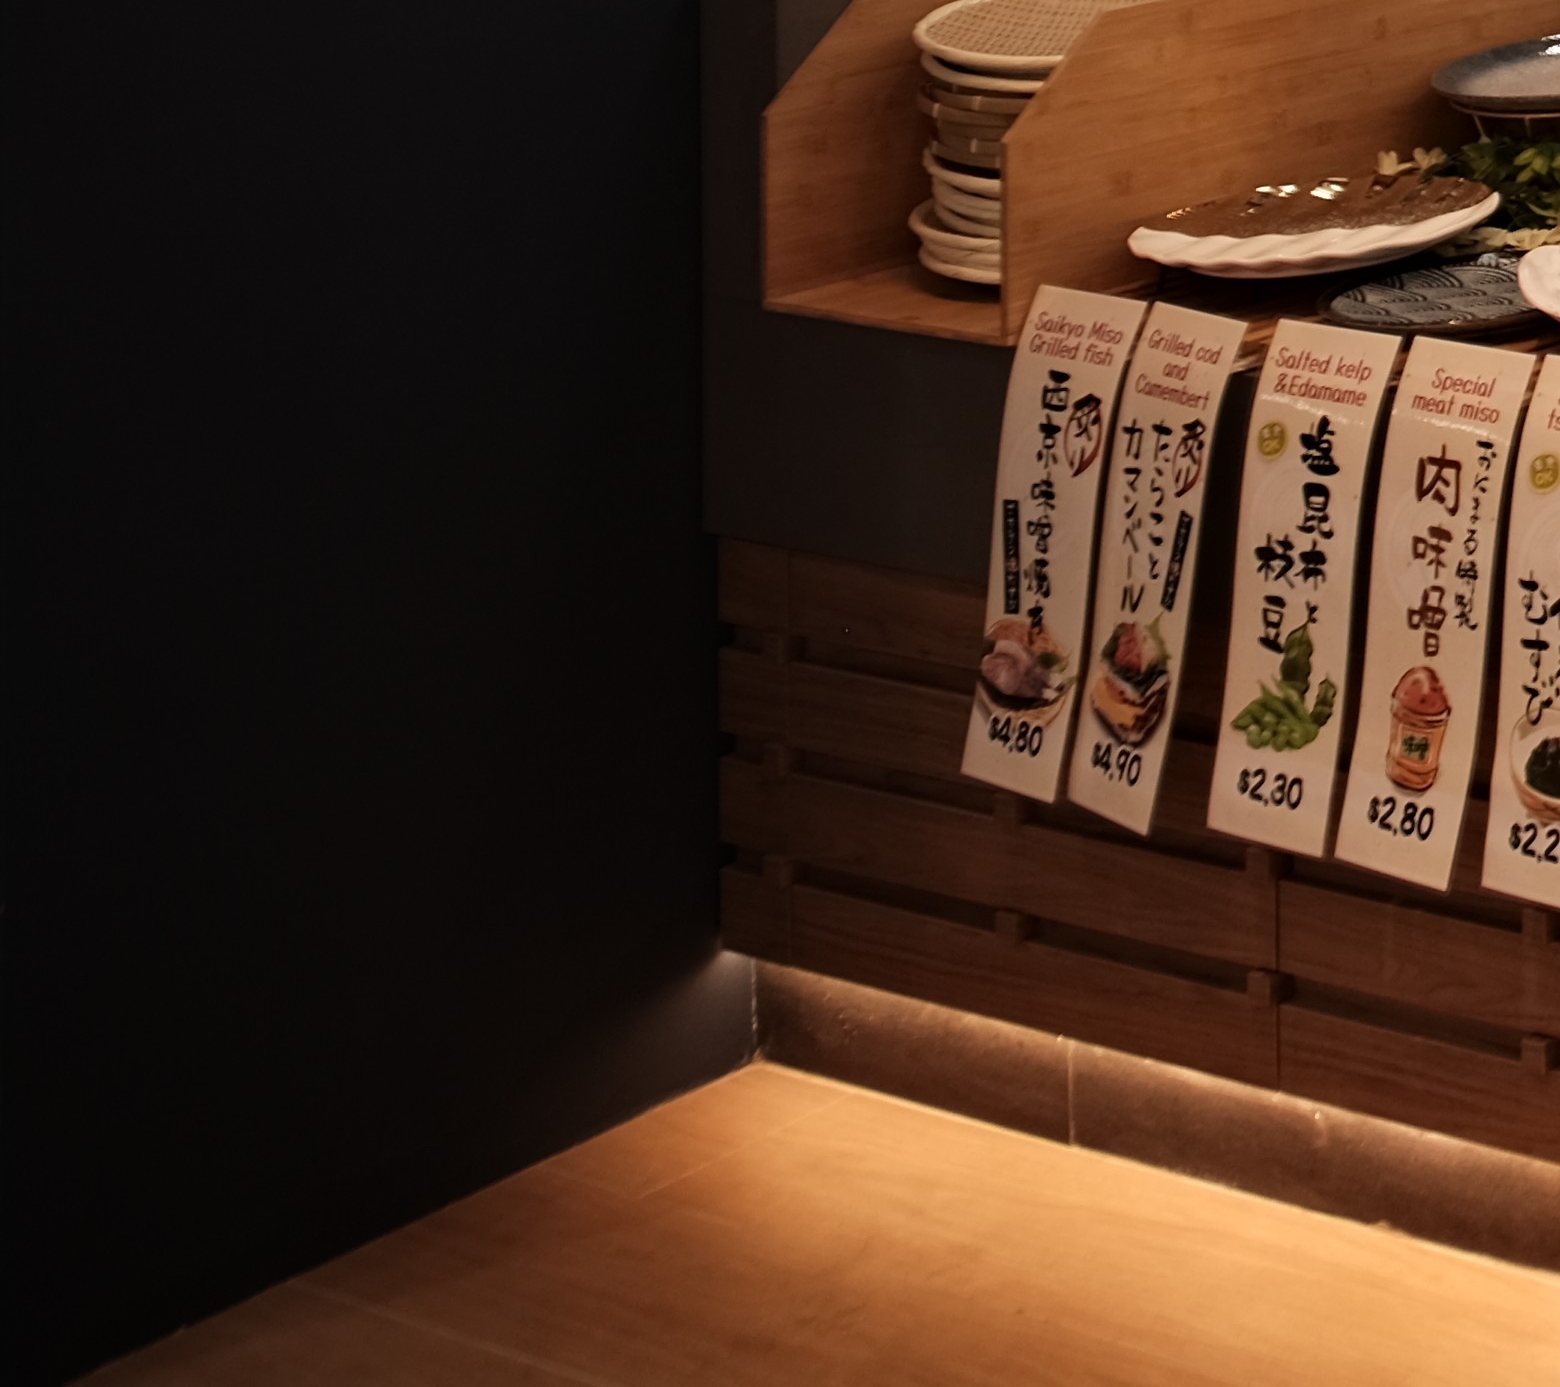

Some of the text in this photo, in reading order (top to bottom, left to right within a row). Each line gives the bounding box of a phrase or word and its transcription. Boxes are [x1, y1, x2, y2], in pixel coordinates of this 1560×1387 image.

[1034, 312, 1123, 345] Saikyo Miso
[1147, 329, 1223, 365] Grilled cod
[1029, 336, 1114, 366] Grilled fish
[1163, 360, 1188, 381] and
[1274, 347, 1371, 382] Salted kelp
[1135, 373, 1211, 411] Camembert
[1431, 368, 1496, 397] Special
[1412, 391, 1500, 423] meat miso
[1120, 425, 1144, 614] カマンベール
[1146, 423, 1173, 580] たらこと
[1294, 415, 1341, 628] 塩昆布と
[1406, 445, 1464, 657] 肉味噌
[1255, 533, 1295, 655] 枝豆
[1518, 575, 1555, 726] むすび
[989, 715, 1043, 757] $4.80
[1091, 741, 1142, 787] $4.90
[1238, 768, 1304, 811] $2.30
[1368, 797, 1435, 841] $2.80
